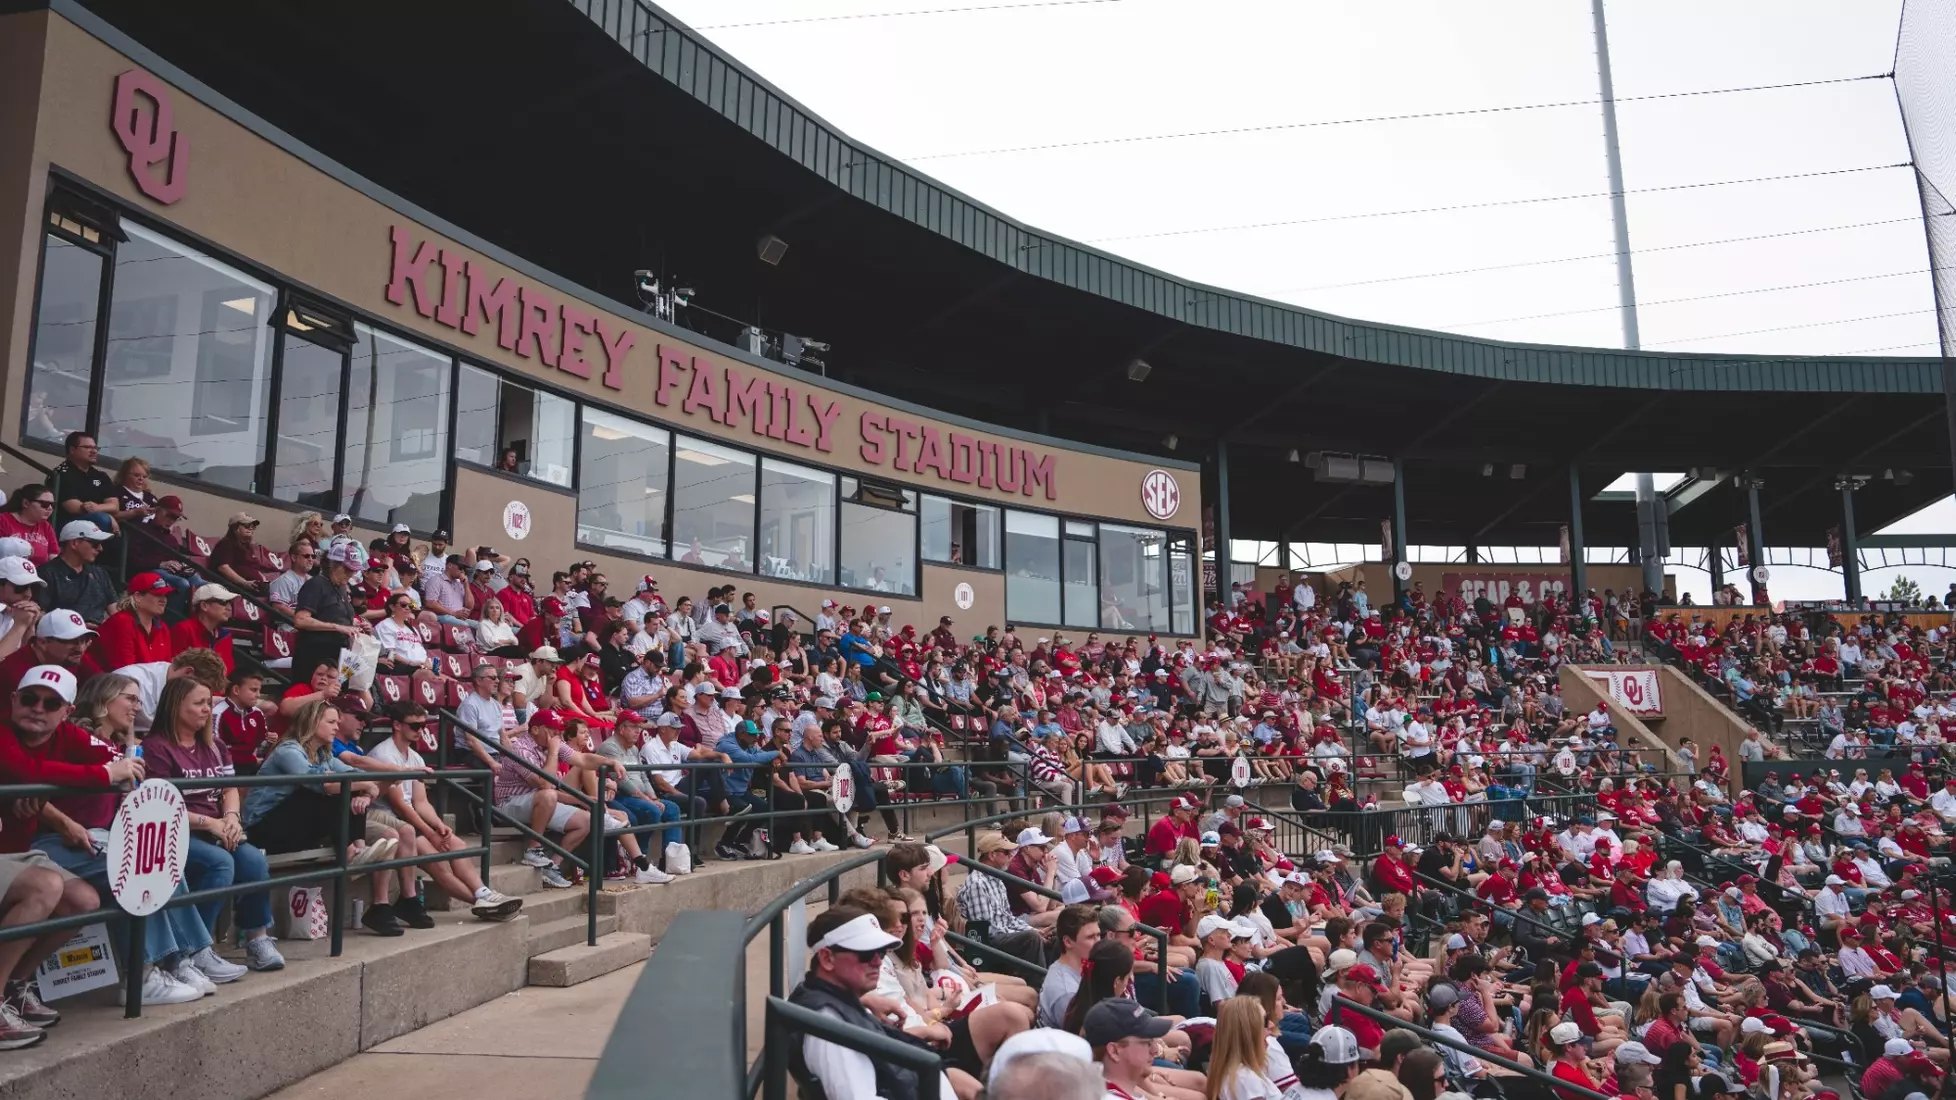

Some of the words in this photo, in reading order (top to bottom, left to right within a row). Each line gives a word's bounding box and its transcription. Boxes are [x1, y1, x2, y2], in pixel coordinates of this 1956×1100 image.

[111, 69, 190, 205] OU
[385, 224, 635, 390] KIMREY
[655, 343, 841, 453] FAMILY
[860, 410, 1058, 500] STADIUM
[1144, 472, 1178, 516] SEC
[1623, 675, 1643, 705] OU
[133, 786, 176, 809] SECTION
[135, 821, 167, 875] 104
